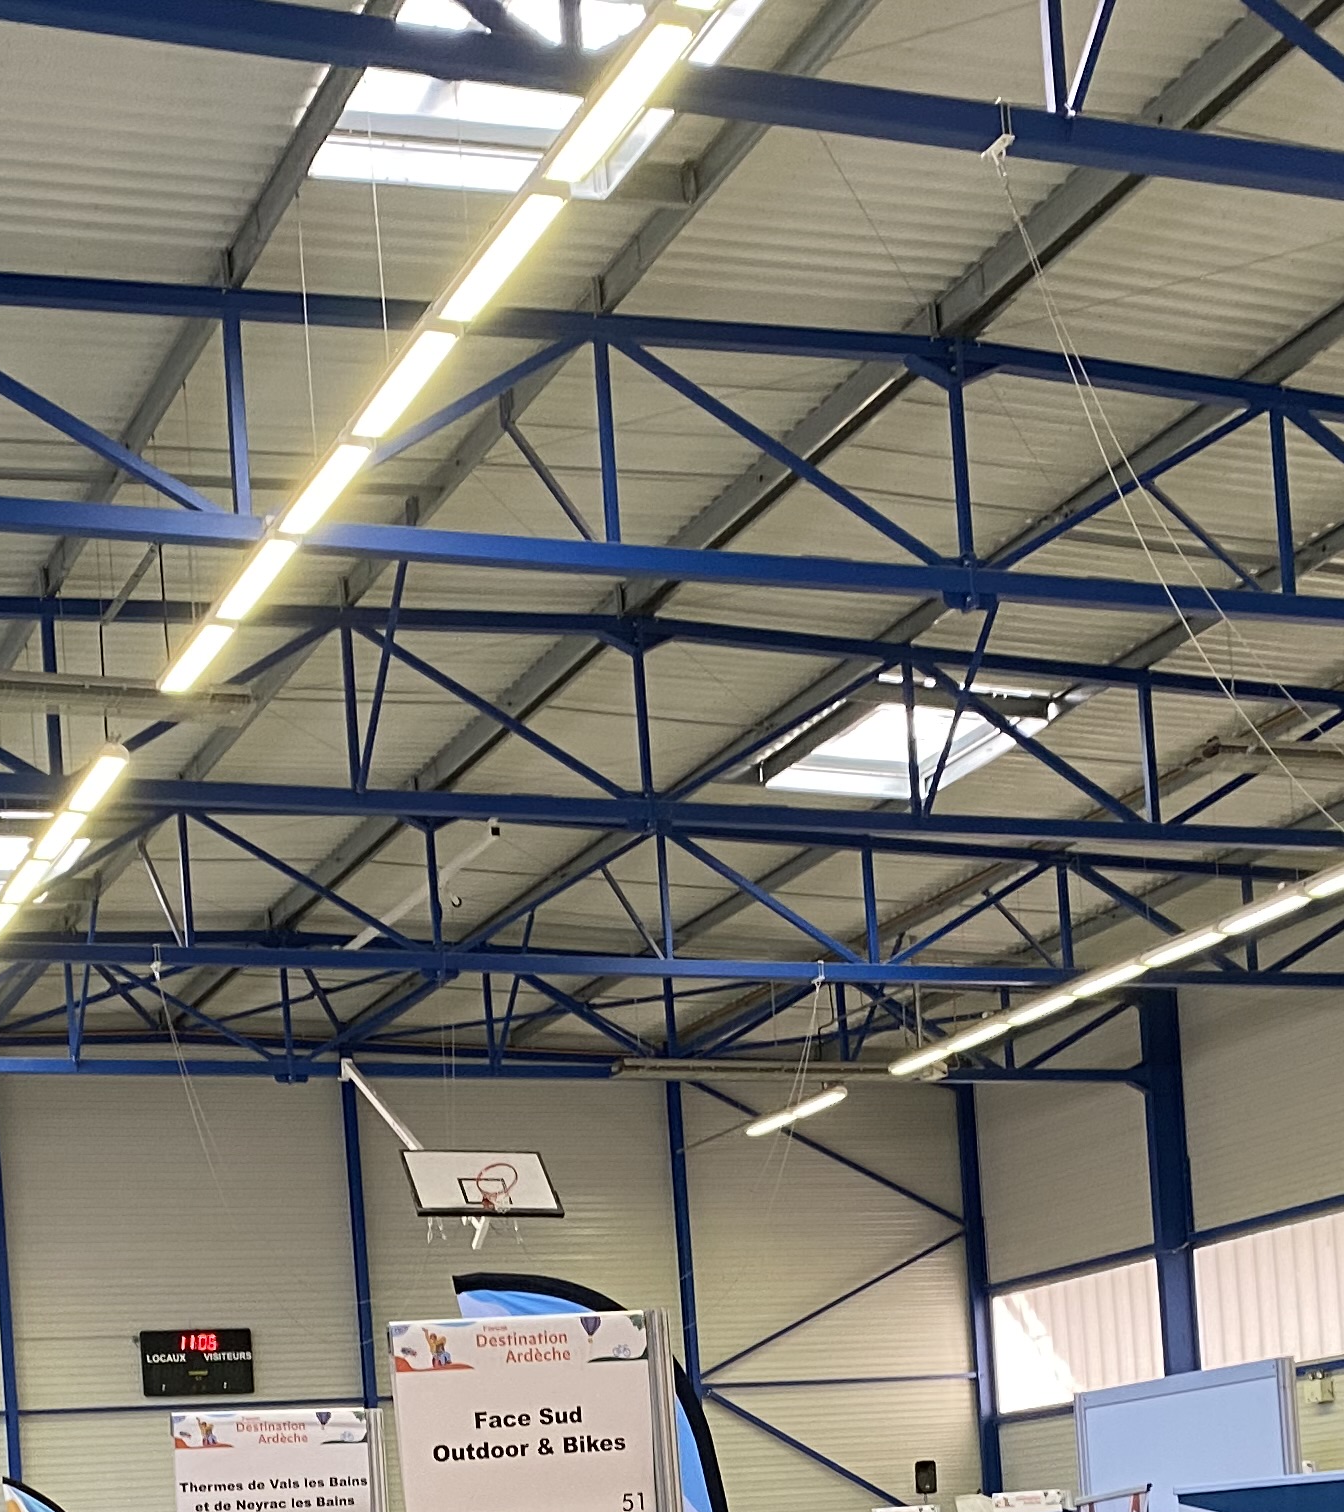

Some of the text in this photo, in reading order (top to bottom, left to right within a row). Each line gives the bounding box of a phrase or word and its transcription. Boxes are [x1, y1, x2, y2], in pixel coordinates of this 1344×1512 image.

[476, 1331, 568, 1348] Destination
[146, 1354, 187, 1364] LOCAUX
[203, 1351, 252, 1362] VISITEURS
[506, 1347, 571, 1364] Ardèche
[236, 1421, 306, 1432] Destination
[474, 1406, 583, 1430] Face Sud
[258, 1433, 308, 1444] Ardèche
[433, 1436, 626, 1462] Outdoor & Bikes
[179, 1475, 368, 1493] Thermes de Vals les Bains
[195, 1495, 355, 1512] et de Neyrac les Bains
[622, 1492, 645, 1512] 51
